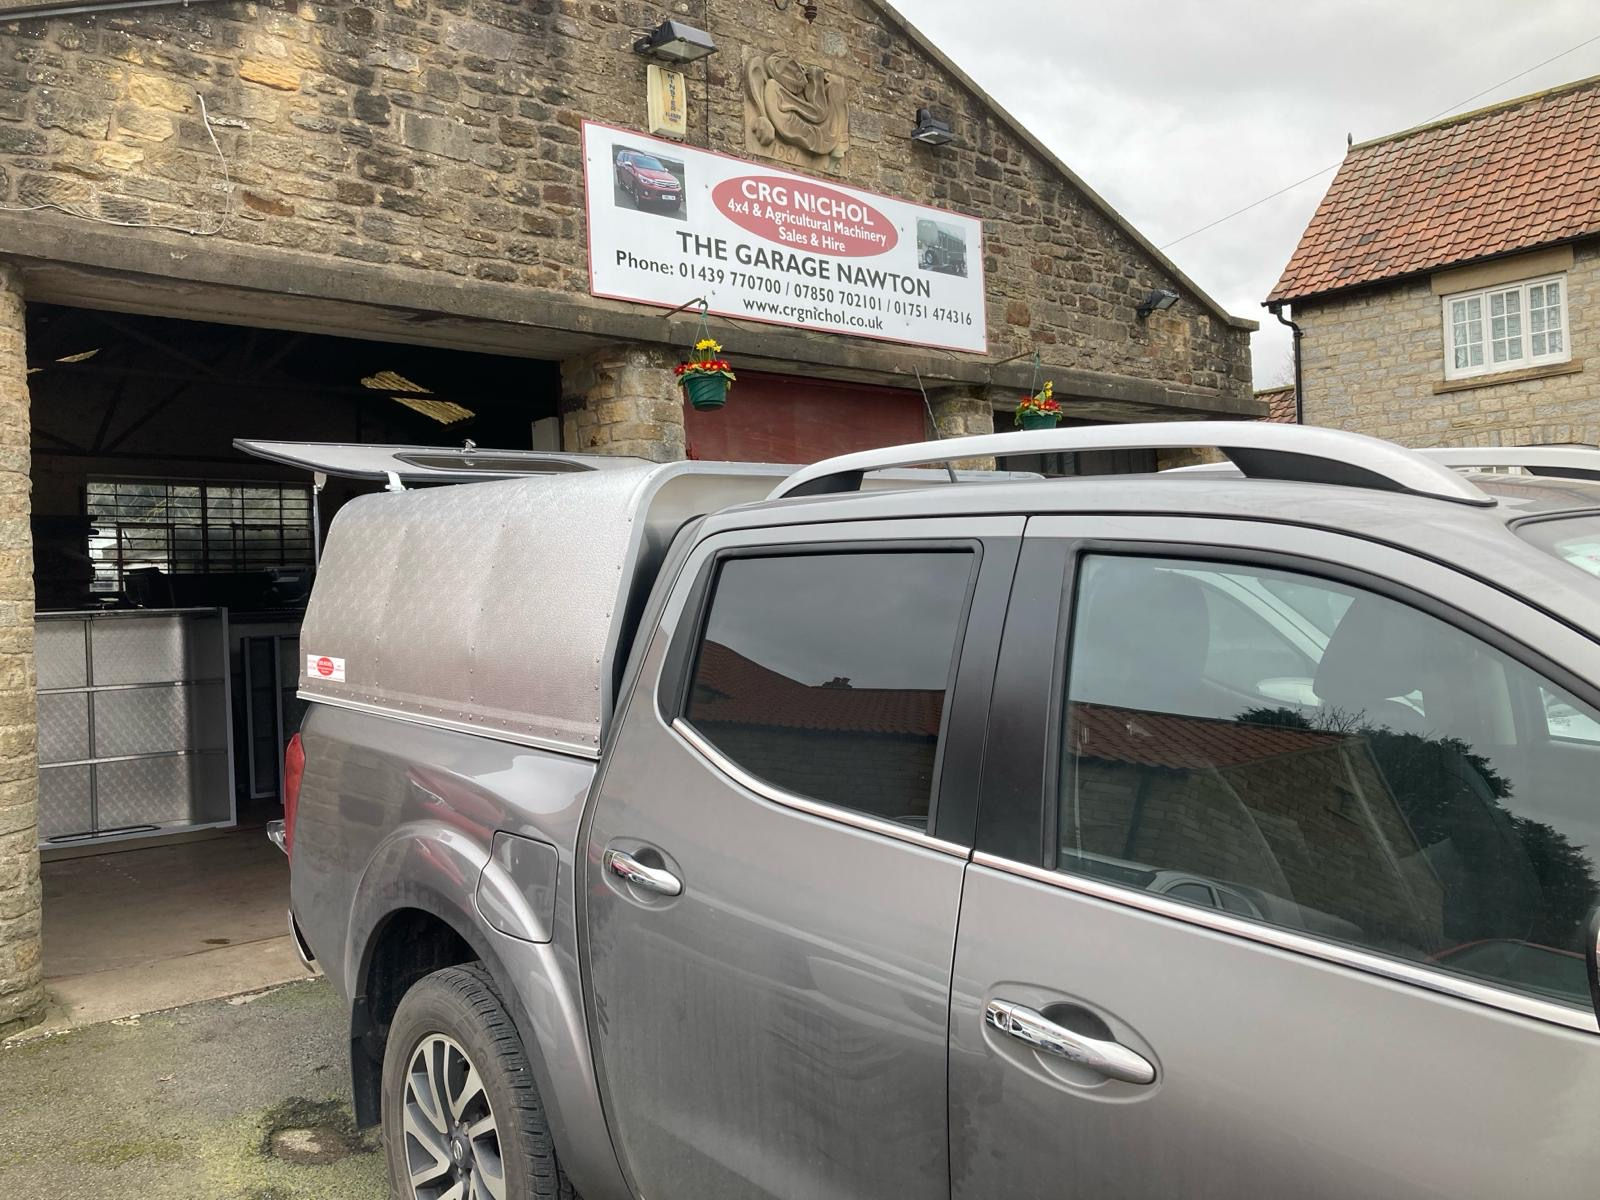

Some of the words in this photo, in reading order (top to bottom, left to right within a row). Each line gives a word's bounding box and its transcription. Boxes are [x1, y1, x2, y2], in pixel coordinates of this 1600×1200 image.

[727, 198, 749, 214] 4x4
[752, 203, 762, 217] &
[765, 207, 831, 232] Agricultural
[834, 221, 887, 247] Machinery
[741, 179, 788, 206] CRG
[794, 191, 874, 226] NICHOL
[778, 227, 808, 244] Sales
[811, 233, 819, 247] &
[822, 237, 846, 252] Hire
[616, 250, 674, 275] Phone:
[679, 262, 725, 284] 01439
[730, 271, 781, 294] 770700
[794, 283, 834, 303] 07850
[838, 291, 881, 311] 702101
[894, 301, 927, 318] 01751
[933, 308, 972, 325] 474316
[676, 231, 728, 261] THE
[735, 244, 830, 280] GARAGE
[837, 263, 931, 298] NAWTON
[743, 298, 884, 330] www.crgnichol.co.uk
